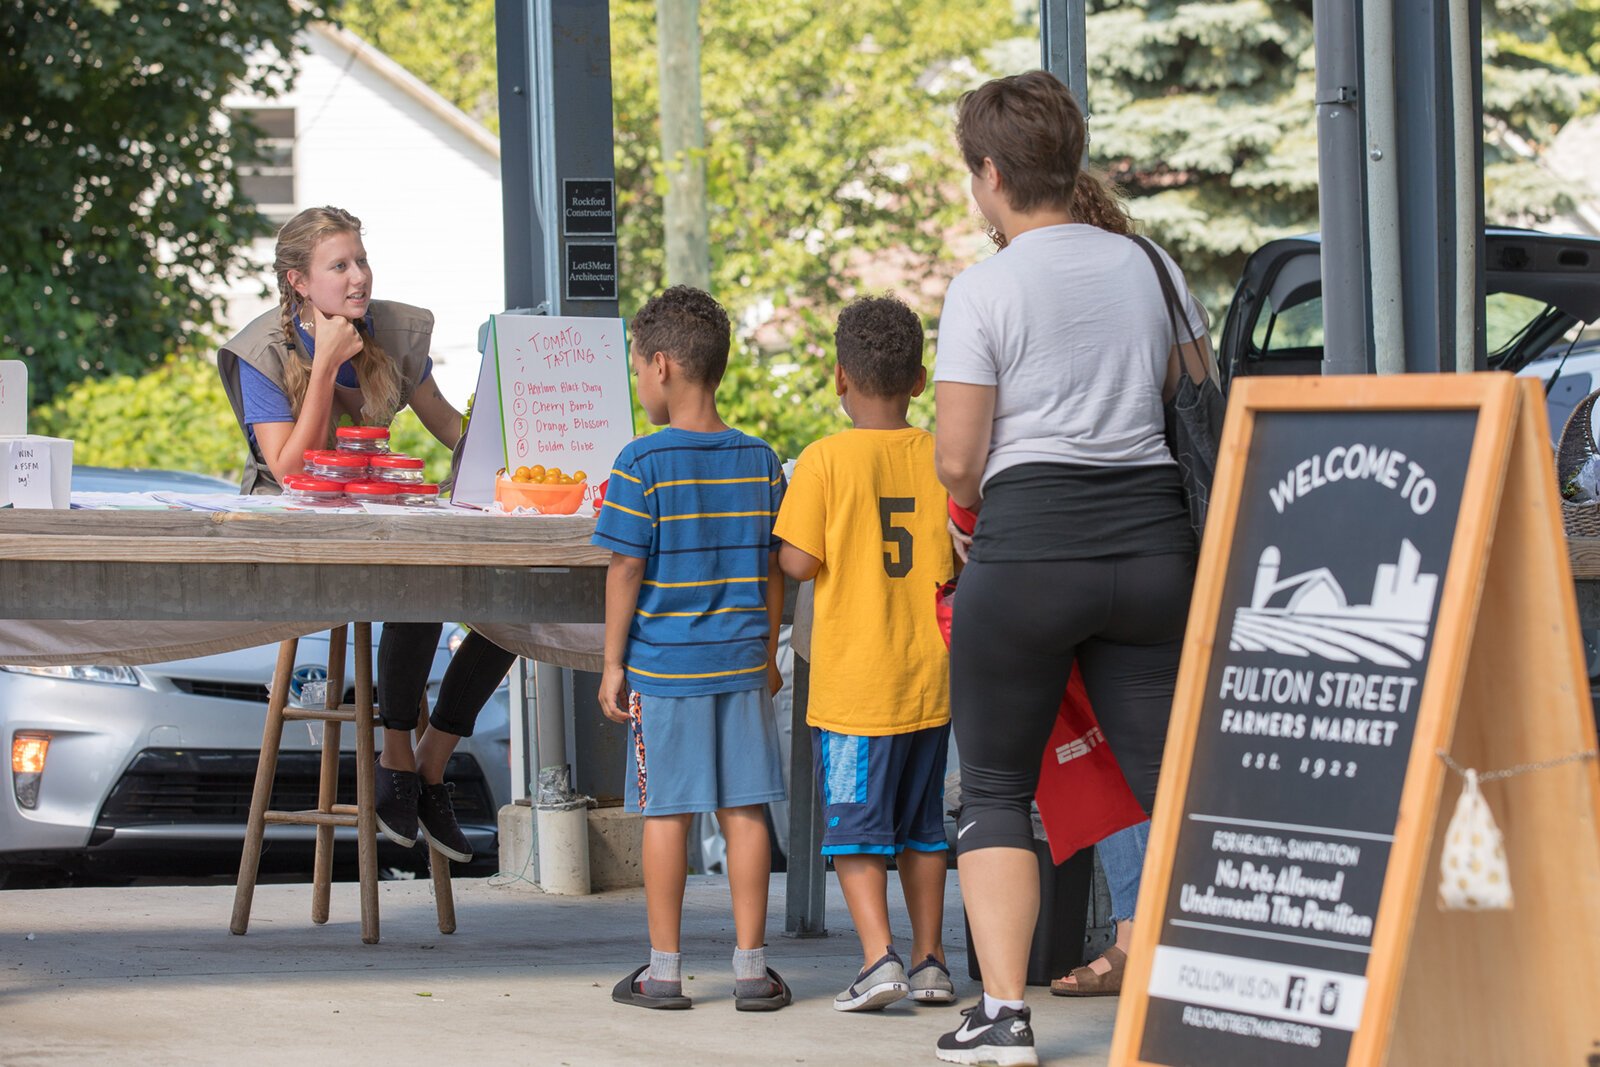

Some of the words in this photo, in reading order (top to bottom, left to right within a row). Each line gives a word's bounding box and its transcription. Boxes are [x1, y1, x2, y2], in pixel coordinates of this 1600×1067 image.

[572, 197, 606, 206] Rockford
[566, 208, 613, 217] Construction
[572, 261, 611, 270] Lott3Metz
[569, 272, 615, 281] Architecture
[528, 326, 582, 352] TOMATO
[543, 348, 595, 369] TASTING
[560, 381, 580, 393] Black
[532, 400, 565, 416] Cherry
[569, 400, 594, 413] Bomb
[536, 419, 568, 437] Orange
[574, 418, 609, 429] Blossom
[18, 449, 33, 458] WIN
[538, 440, 565, 453] Golden
[571, 440, 594, 451] Globe
[1269, 443, 1407, 514] WELCOME
[1401, 461, 1437, 515] TO
[879, 497, 915, 578] 5
[1219, 666, 1314, 705] FULTON
[1315, 671, 1418, 713] STREET
[1220, 709, 1306, 739] FARMERS
[1310, 716, 1399, 747] MARKET
[1299, 757, 1357, 779] 1922
[1212, 830, 1236, 853] FOR
[1234, 833, 1282, 858] HEALTH
[1286, 838, 1360, 867] SANITATION
[1214, 859, 1240, 888] No
[1239, 861, 1276, 893] Pets
[1274, 865, 1345, 901] Allowed
[1180, 883, 1270, 923] Underneath
[1271, 895, 1303, 927] The
[1302, 900, 1373, 937] Pavilion
[1178, 965, 1235, 992] FOLLOW
[1239, 975, 1257, 998] US
[1257, 977, 1281, 1001] ON
